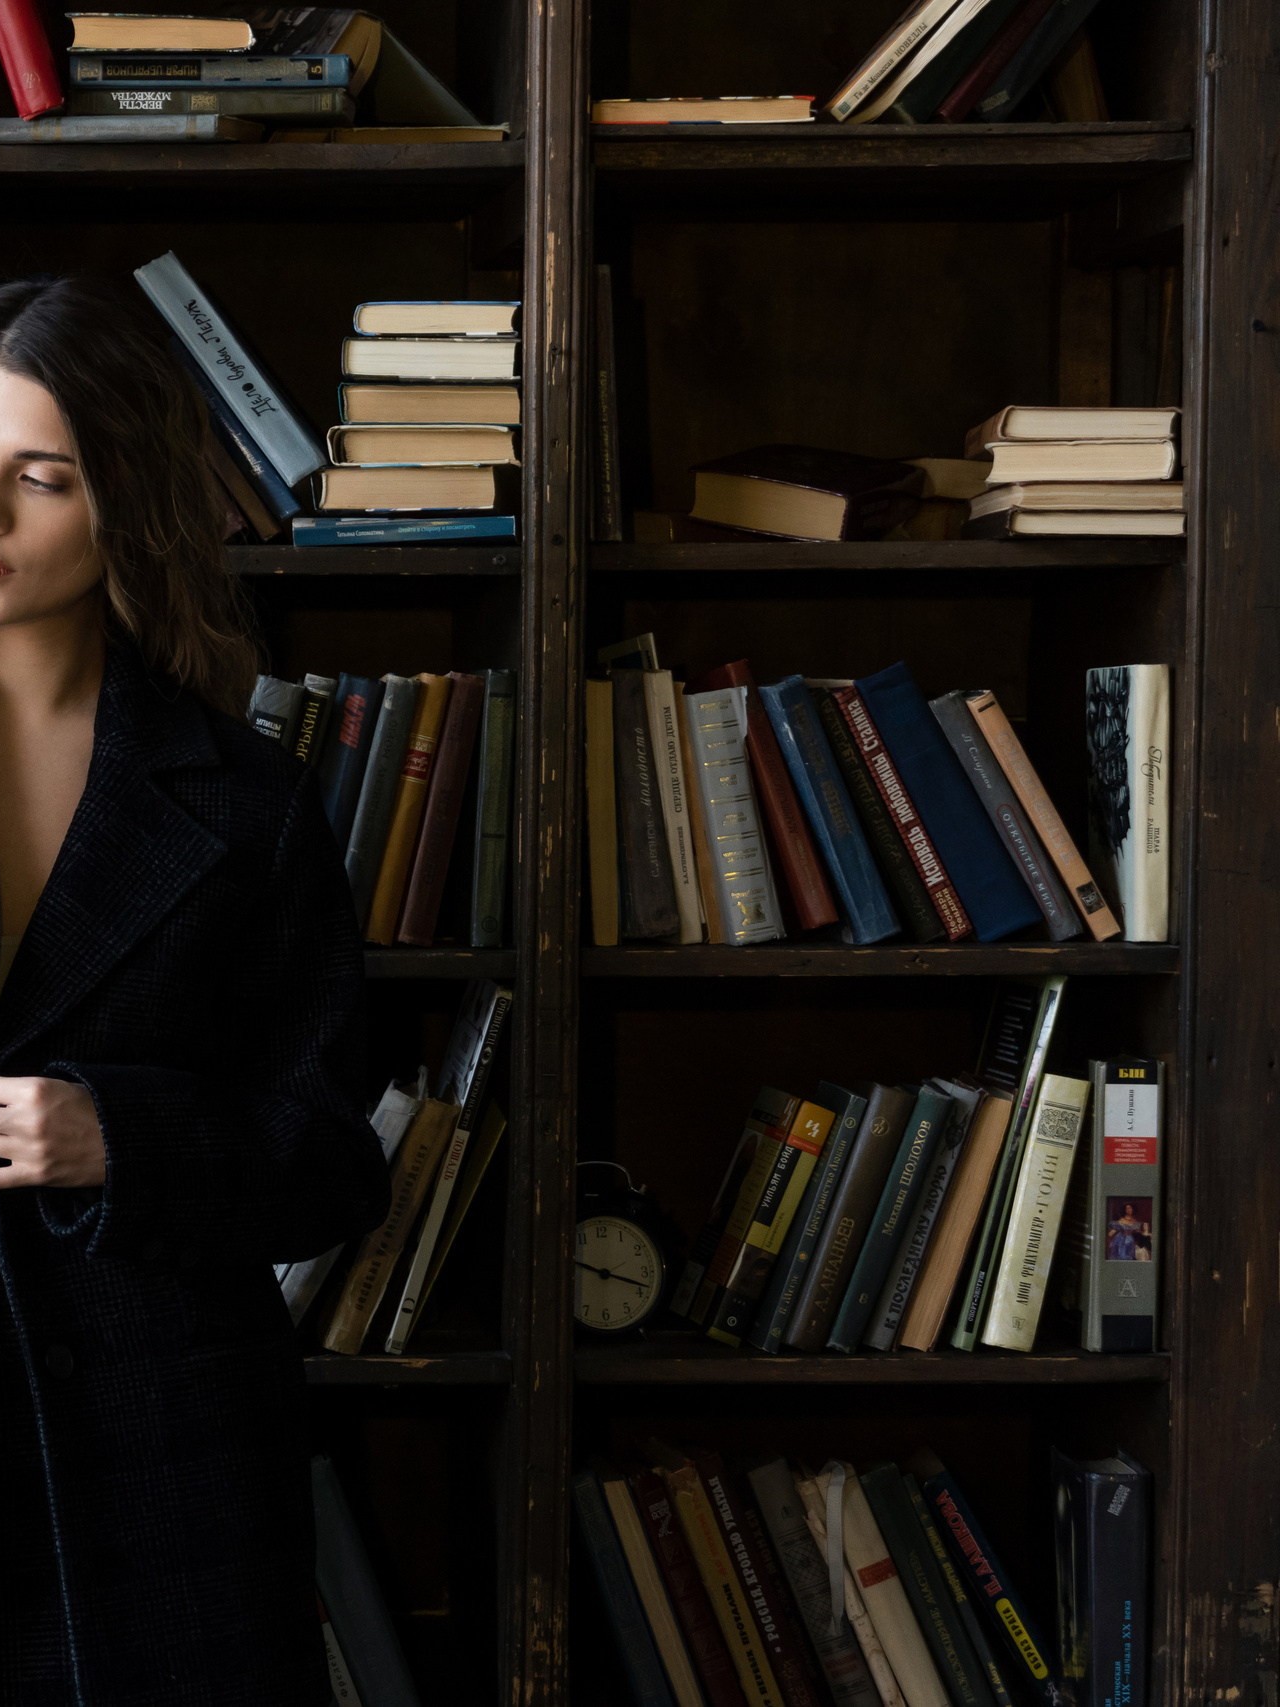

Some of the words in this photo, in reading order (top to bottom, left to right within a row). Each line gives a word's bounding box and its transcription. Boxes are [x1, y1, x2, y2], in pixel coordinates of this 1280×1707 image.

[311, 63, 322, 75] 5
[867, 58, 895, 86] Мопассан
[894, 22, 928, 57] НОВЕЛЛЫ
[111, 91, 171, 102] МУЖЕСТВА
[120, 100, 163, 110] ВЕРСТЫ
[337, 530, 355, 538] Татьяна
[355, 529, 384, 537] Соломатина
[665, 705, 675, 740] ДЕТЯМ
[847, 698, 879, 752] Сталина
[670, 743, 679, 779] ОТДАЮ
[968, 746, 992, 790] Смирнов
[1141, 745, 1162, 806] Победители
[674, 781, 682, 814] СЕРДЦЕ
[872, 752, 915, 825] любовницы
[908, 825, 945, 888] Исповедь
[1002, 813, 1042, 878] ОТКРЫТИЕ
[1037, 882, 1056, 918] МИРА
[935, 892, 960, 934] Леонард
[942, 887, 967, 931] Гендлин
[485, 997, 507, 1048] ОЧЕВИДЕЦ
[1119, 1068, 1146, 1079] БШ
[1127, 1089, 1136, 1117] Пушкин
[444, 1135, 466, 1182] ЛОШАДЬ
[761, 1170, 782, 1209] УИЛЬЯМ
[777, 1144, 795, 1170] БОЙД
[880, 1187, 908, 1238] Михаил
[900, 1120, 932, 1188] ШОЛОХОВ
[805, 1167, 835, 1239] Пространство
[832, 1139, 847, 1169] Любви
[925, 1164, 947, 1214] МОРЮ
[595, 1227, 608, 1239] 12
[618, 1231, 623, 1243] 1
[1023, 1216, 1045, 1281] ФЕЙХТВАНГЕР
[1039, 1154, 1059, 1208] ГОЙЯ
[634, 1245, 641, 1256] 2
[819, 1215, 856, 1296] АНАНЬЕВ
[888, 1215, 934, 1318] ПОСЛЕДНЕМУ
[356, 1265, 381, 1312] ПОСОБИЕ
[640, 1266, 649, 1278] 3
[583, 1305, 590, 1317] 7
[602, 1309, 610, 1321] 6
[623, 1302, 631, 1314] 5
[883, 1318, 896, 1330] К
[935, 1488, 994, 1578] ДАШКОВА
[729, 1531, 758, 1586] КРОВЬЮ
[941, 1561, 967, 1603] Энергия
[750, 1584, 780, 1642] РОССИЯ,
[1001, 1606, 1023, 1638] ВРАГА
[1122, 1623, 1131, 1639] XX
[1124, 1600, 1132, 1620] века
[745, 1649, 769, 1697] ПЕРВЫХ
[1019, 1638, 1043, 1671] ОБРАЗ
